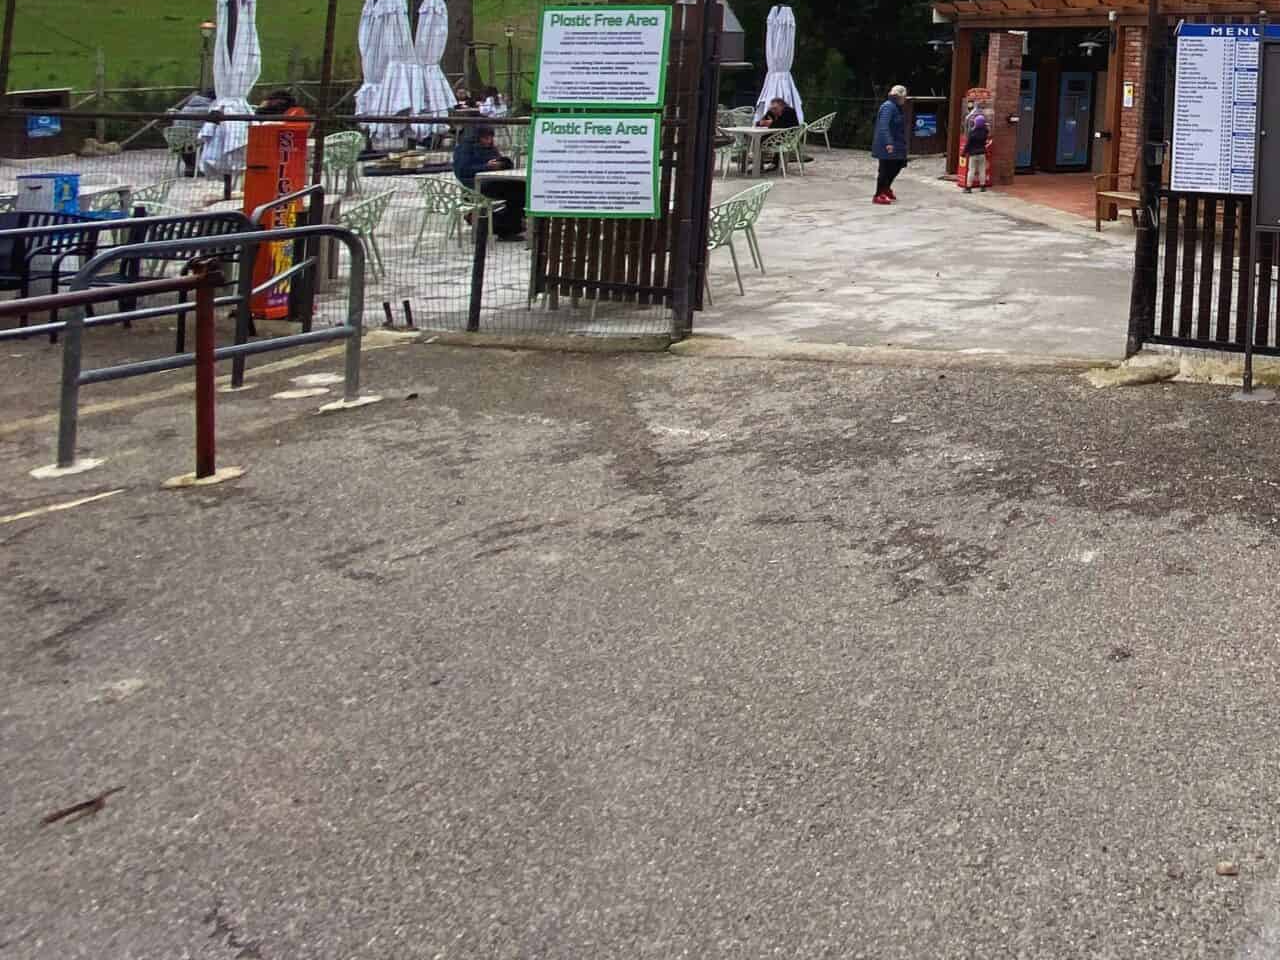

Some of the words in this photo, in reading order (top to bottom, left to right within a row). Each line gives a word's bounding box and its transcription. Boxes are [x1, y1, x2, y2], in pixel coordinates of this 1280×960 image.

[550, 13, 591, 27] Plastic
[593, 14, 623, 26] Free
[625, 14, 658, 27] Area
[541, 121, 581, 135] Plastic
[583, 122, 612, 135] Free
[615, 122, 648, 135] Area
